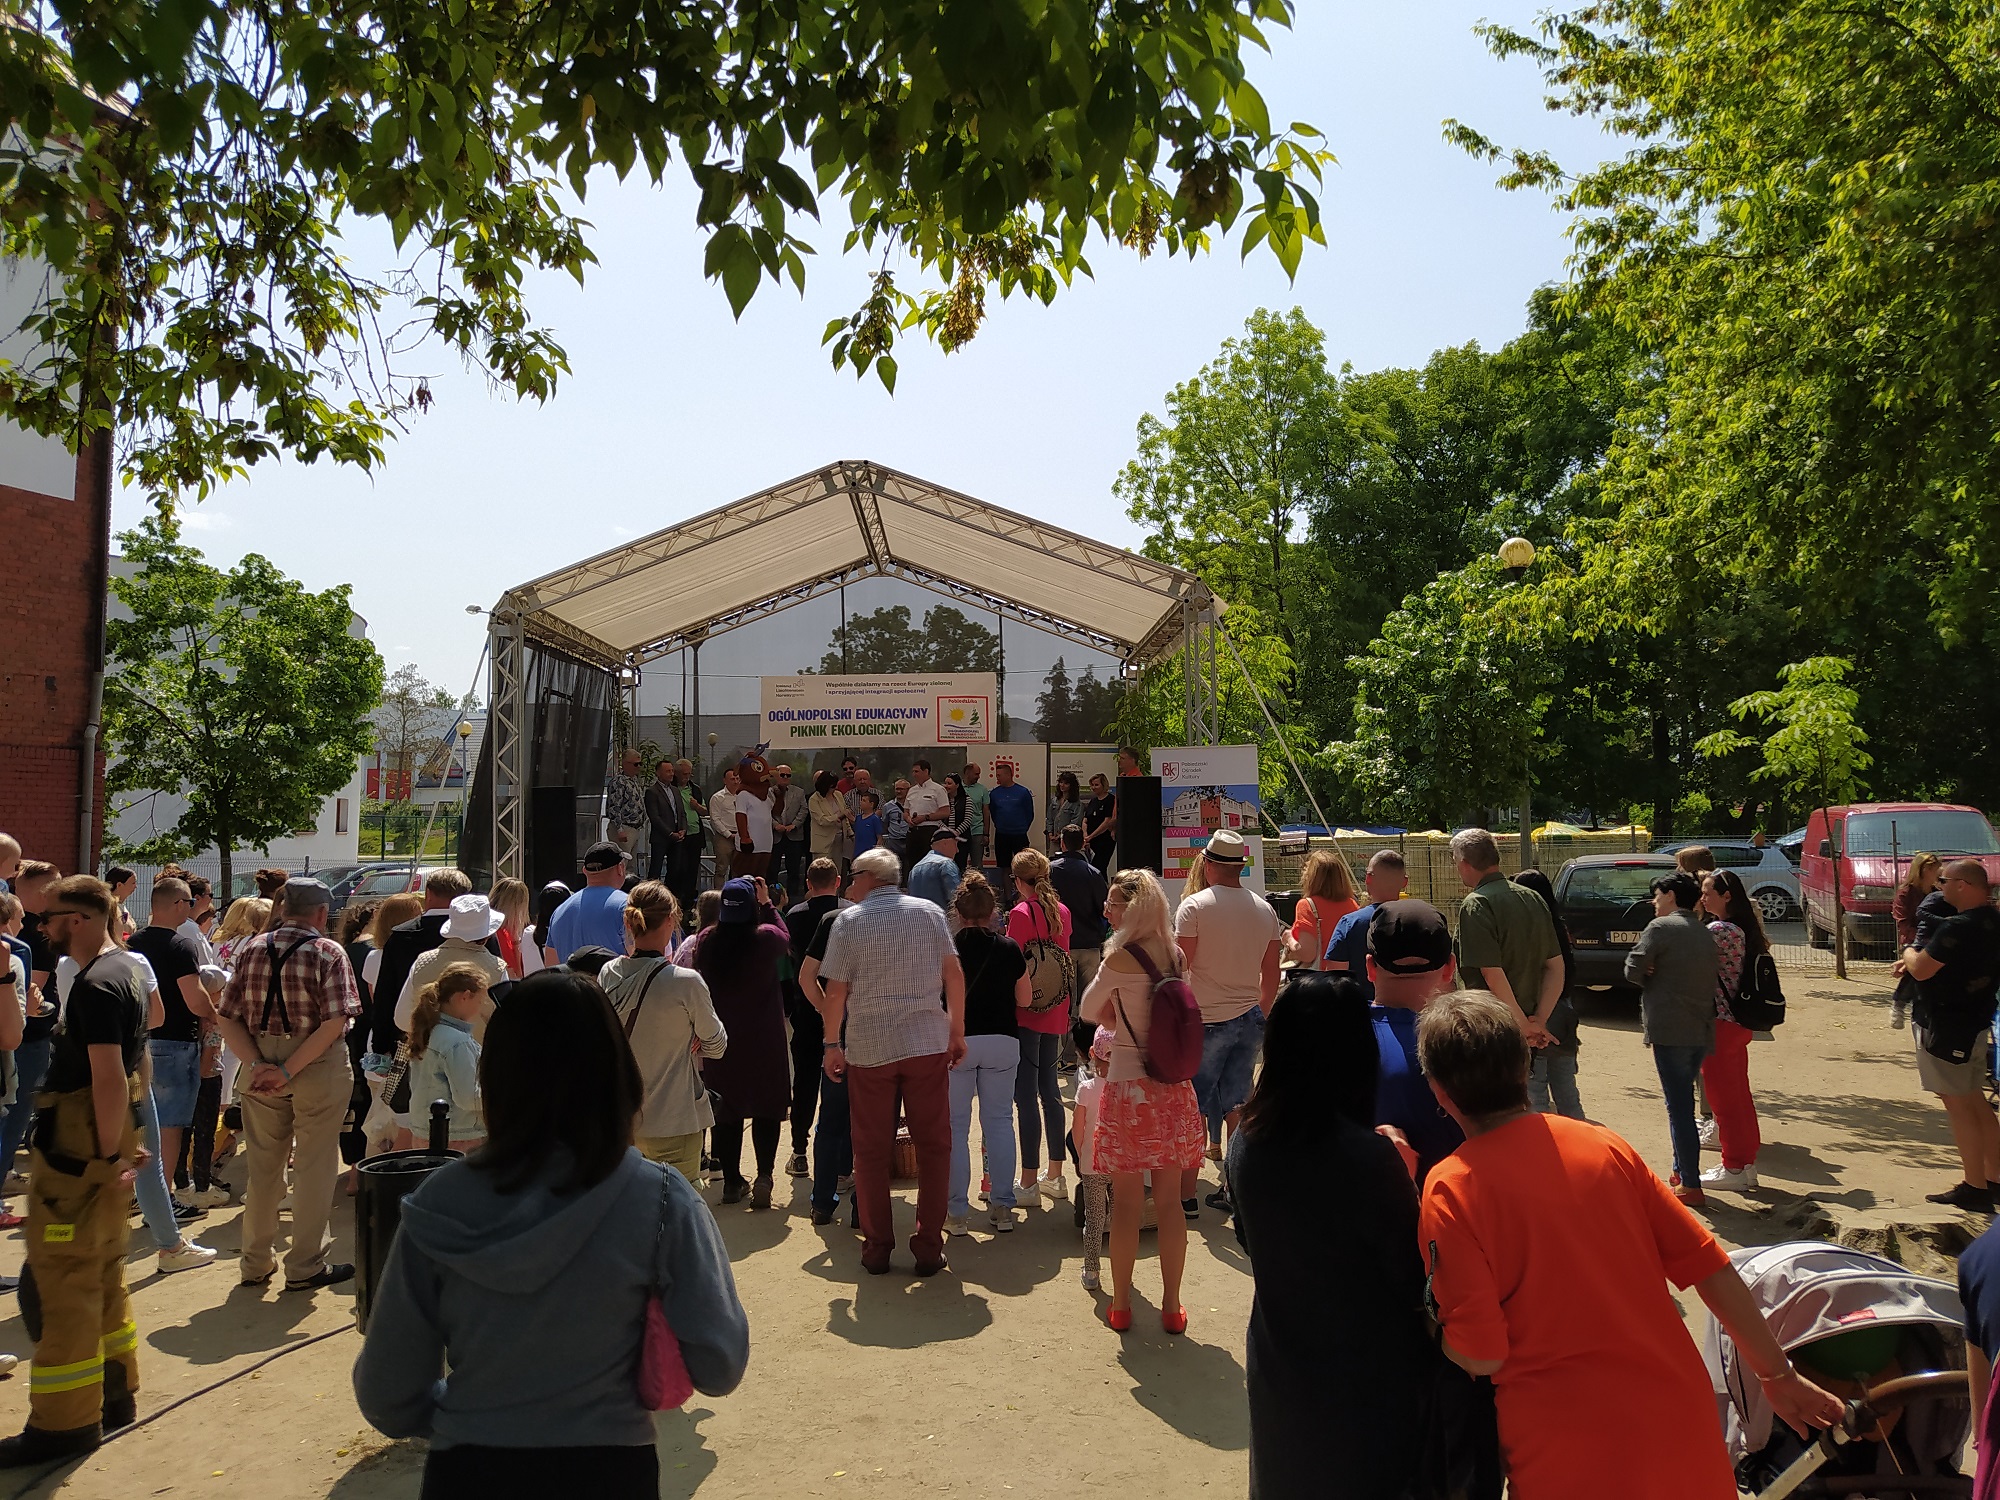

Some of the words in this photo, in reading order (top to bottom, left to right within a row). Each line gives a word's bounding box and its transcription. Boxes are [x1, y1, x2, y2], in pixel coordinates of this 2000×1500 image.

[825, 681, 853, 689] Wspólnie
[853, 681, 881, 689] działamy
[768, 707, 852, 722] OGÓLNOPOLSKI
[855, 707, 929, 720] EDUKACYJNY
[790, 724, 828, 738] PIKNIK
[831, 723, 907, 737] EKOLOGICZNY
[1170, 828, 1204, 836] WIWATY
[1613, 932, 1628, 942] PO
